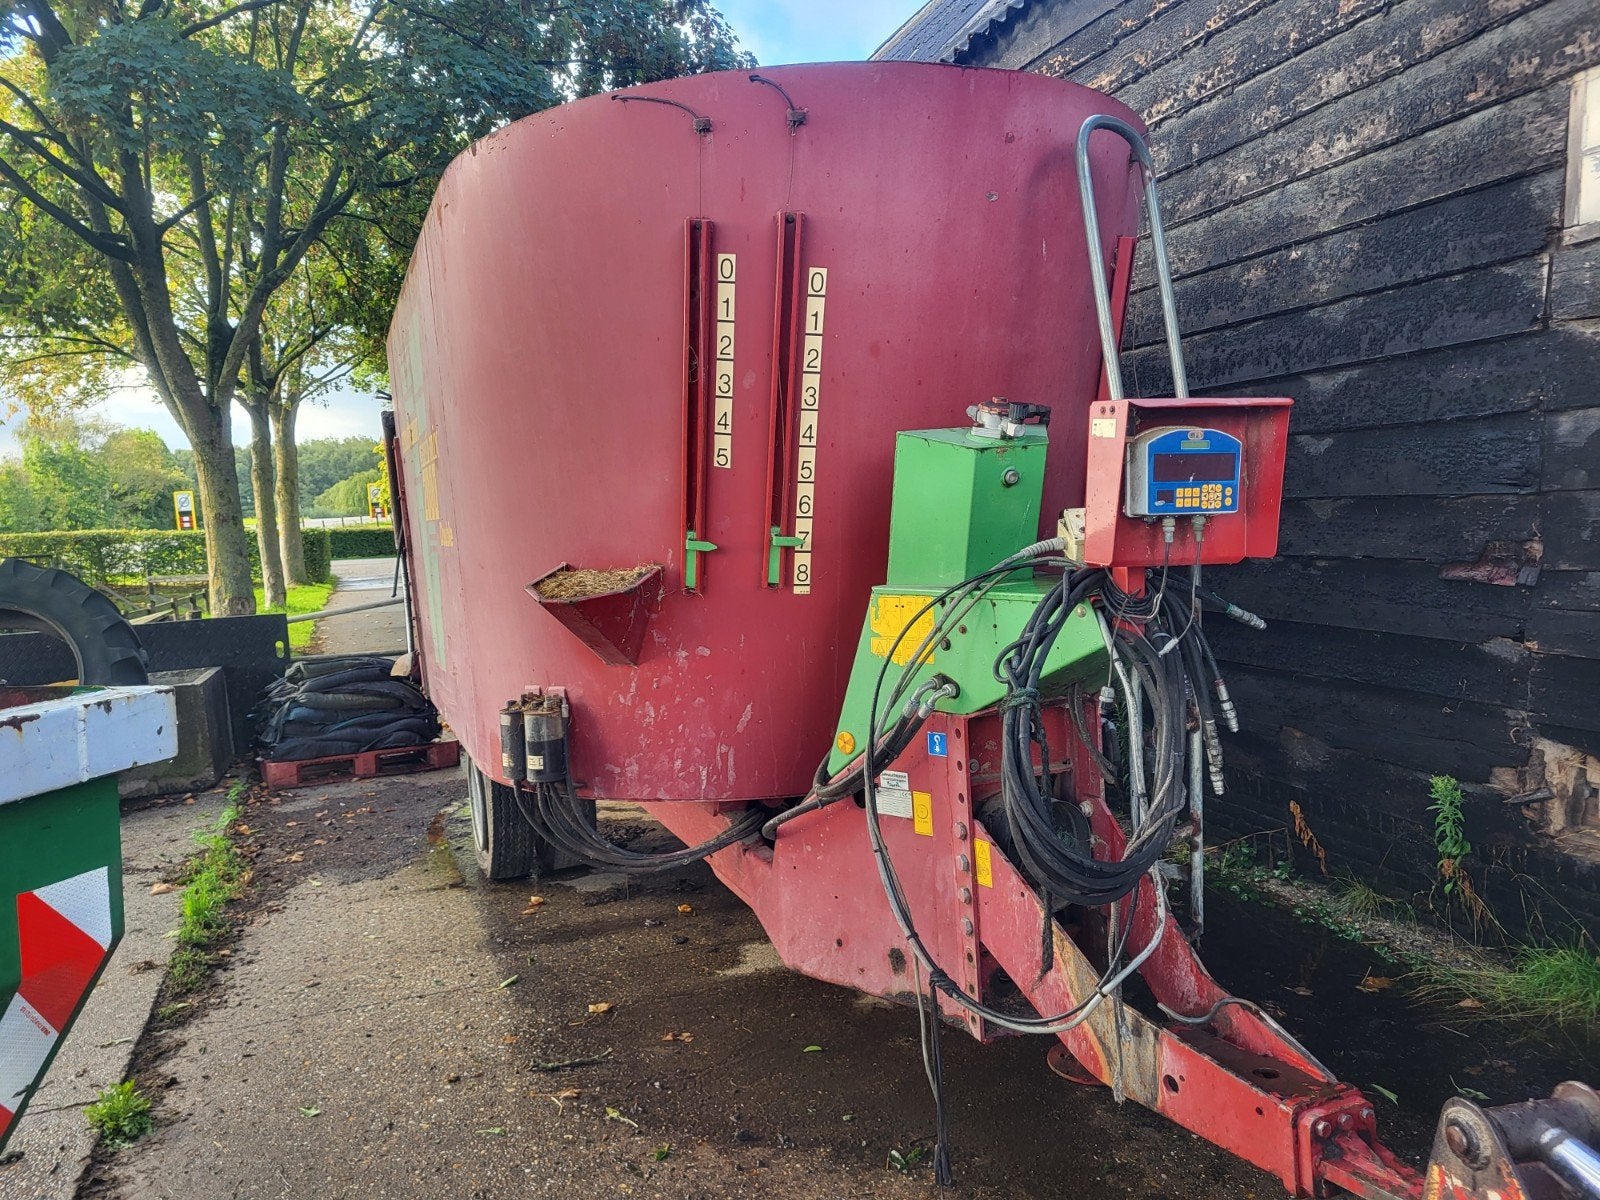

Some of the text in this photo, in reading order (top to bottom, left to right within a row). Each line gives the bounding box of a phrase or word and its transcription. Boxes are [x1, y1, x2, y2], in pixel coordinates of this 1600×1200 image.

[720, 258, 734, 279] 0
[810, 272, 824, 293] 0
[722, 297, 730, 318] 1
[811, 311, 819, 331] 1
[719, 335, 732, 356] 2
[806, 348, 819, 369] 2
[718, 373, 731, 394] 3
[803, 386, 817, 407] 3
[717, 411, 730, 430] 4
[802, 423, 814, 443] 4
[716, 447, 729, 467] 5
[800, 460, 812, 480] 5
[798, 495, 811, 514] 6
[798, 531, 810, 549] 7
[796, 564, 809, 582] 8
